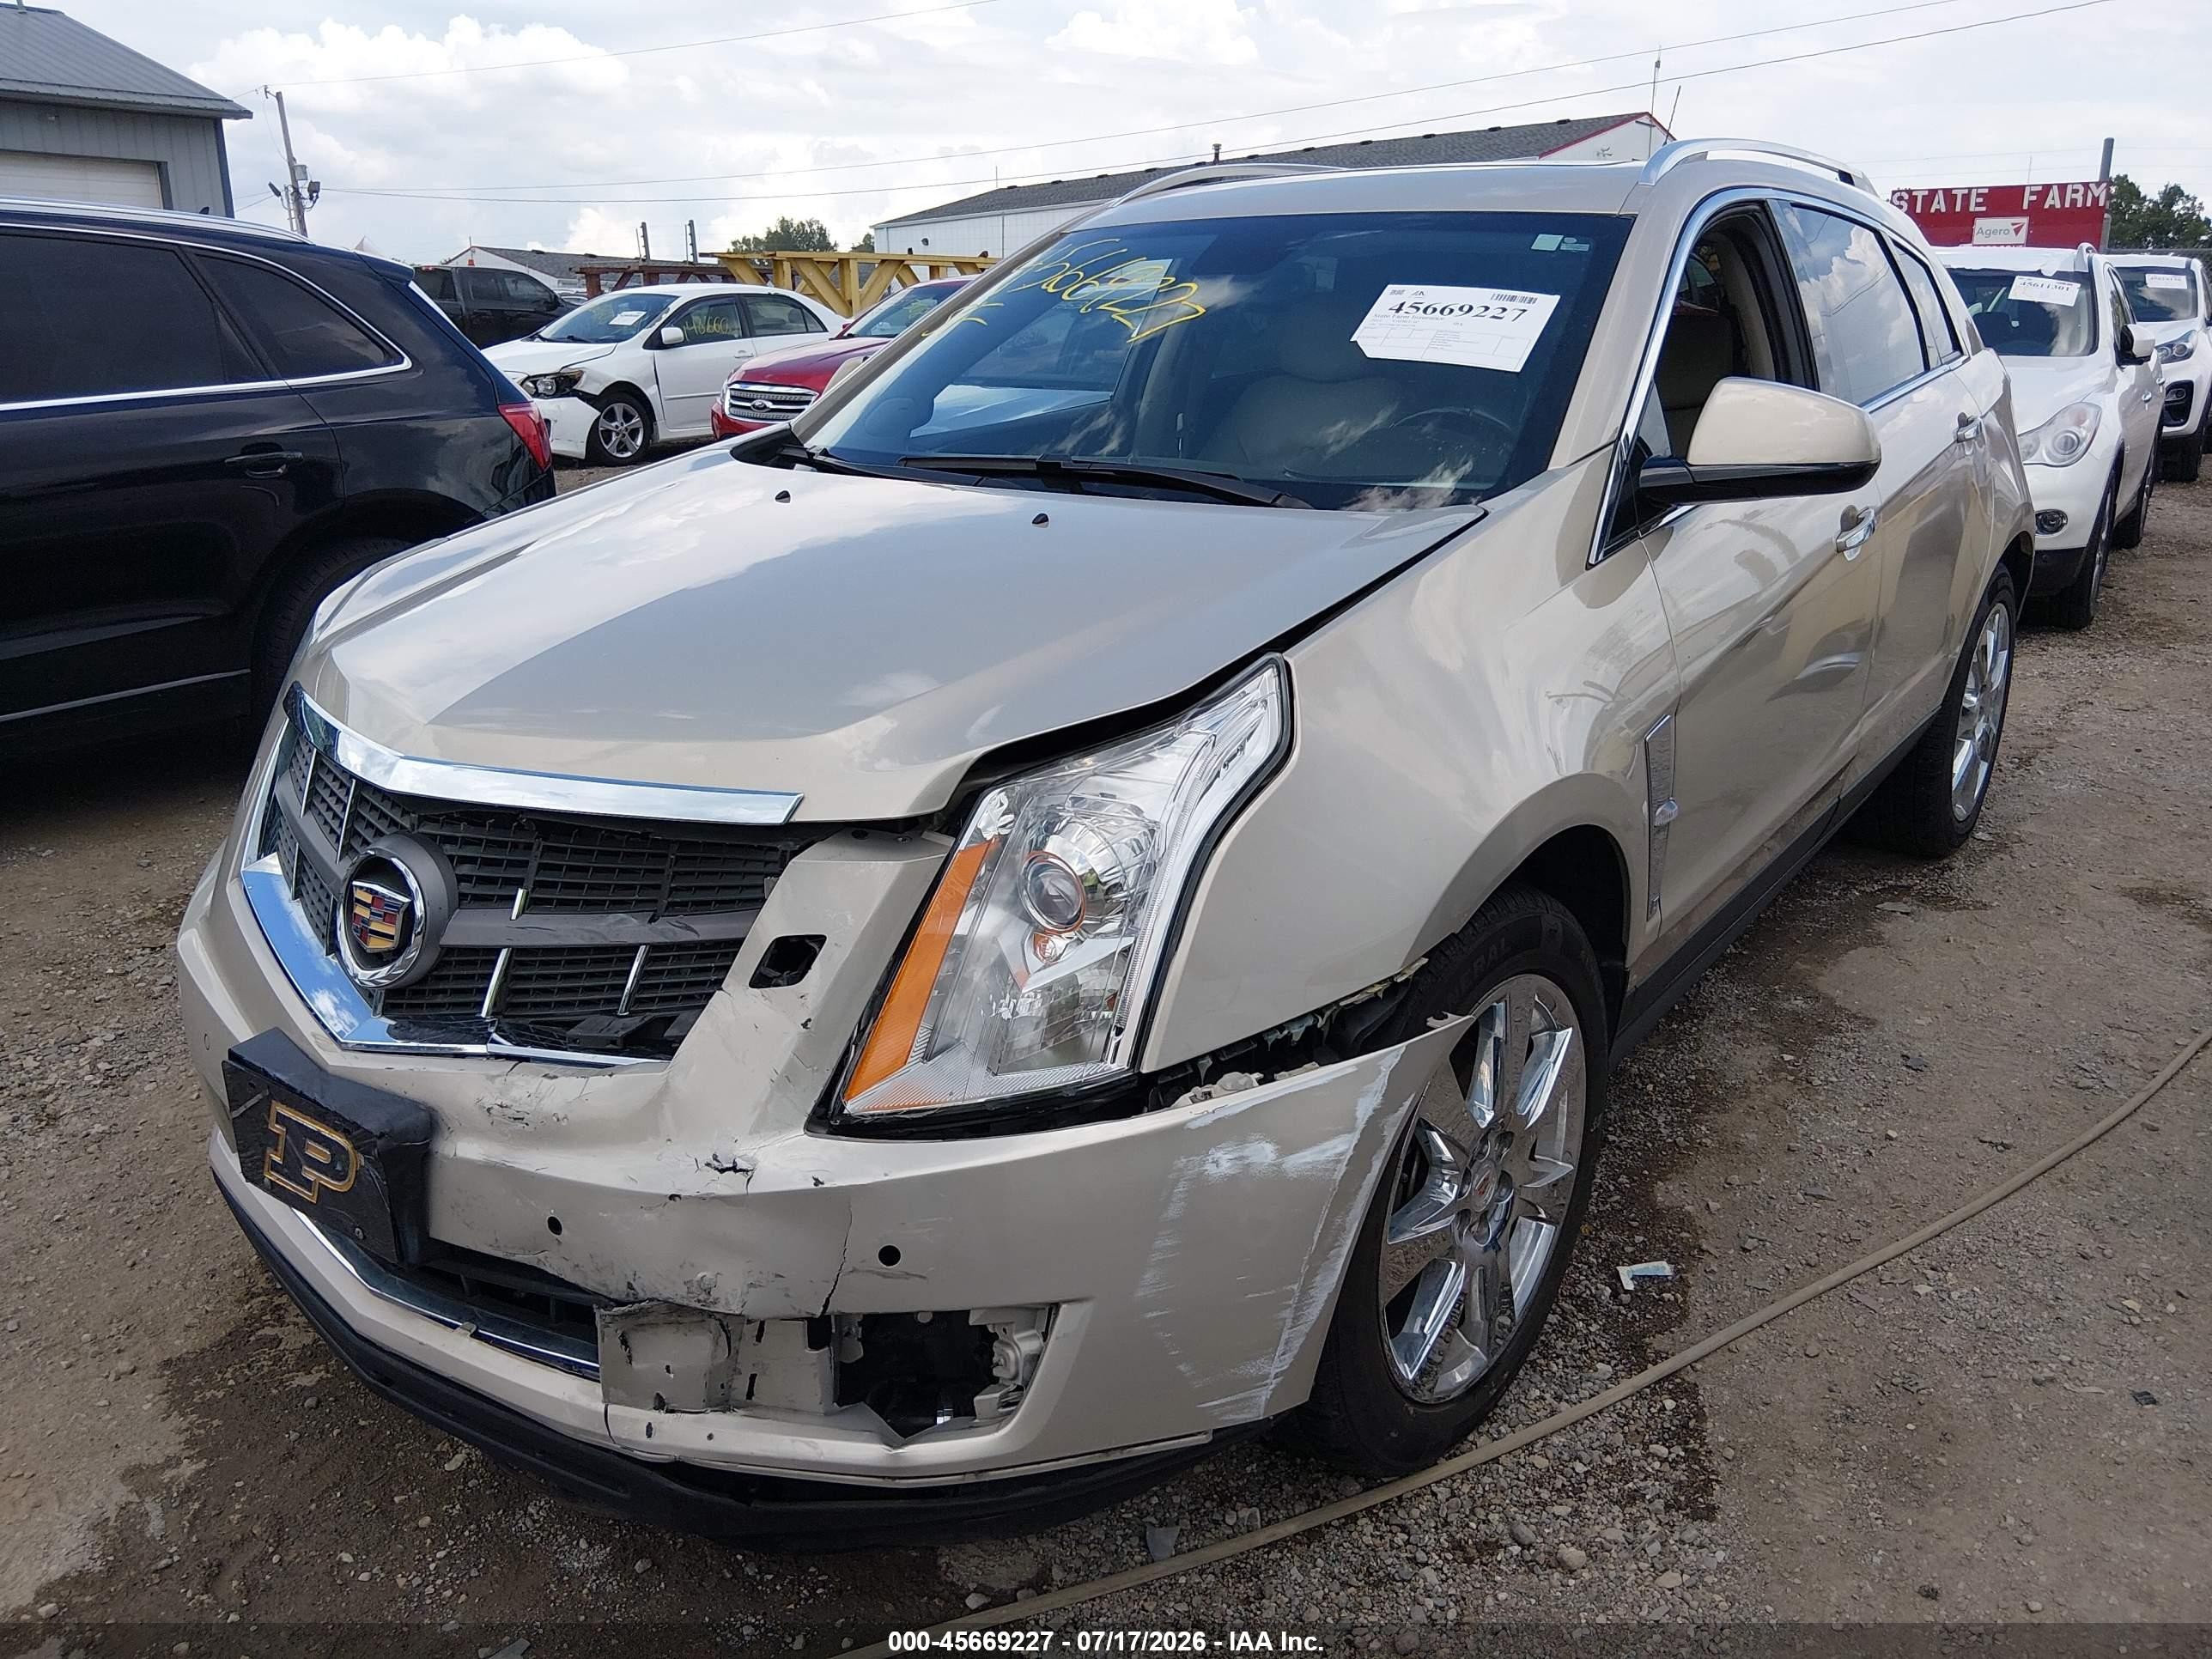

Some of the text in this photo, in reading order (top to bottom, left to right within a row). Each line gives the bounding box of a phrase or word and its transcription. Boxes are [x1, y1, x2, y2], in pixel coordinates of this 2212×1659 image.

[1892, 182, 2107, 214] STATE FARM
[1976, 227, 2010, 239] Agero
[1388, 301, 1528, 322] 45669227
